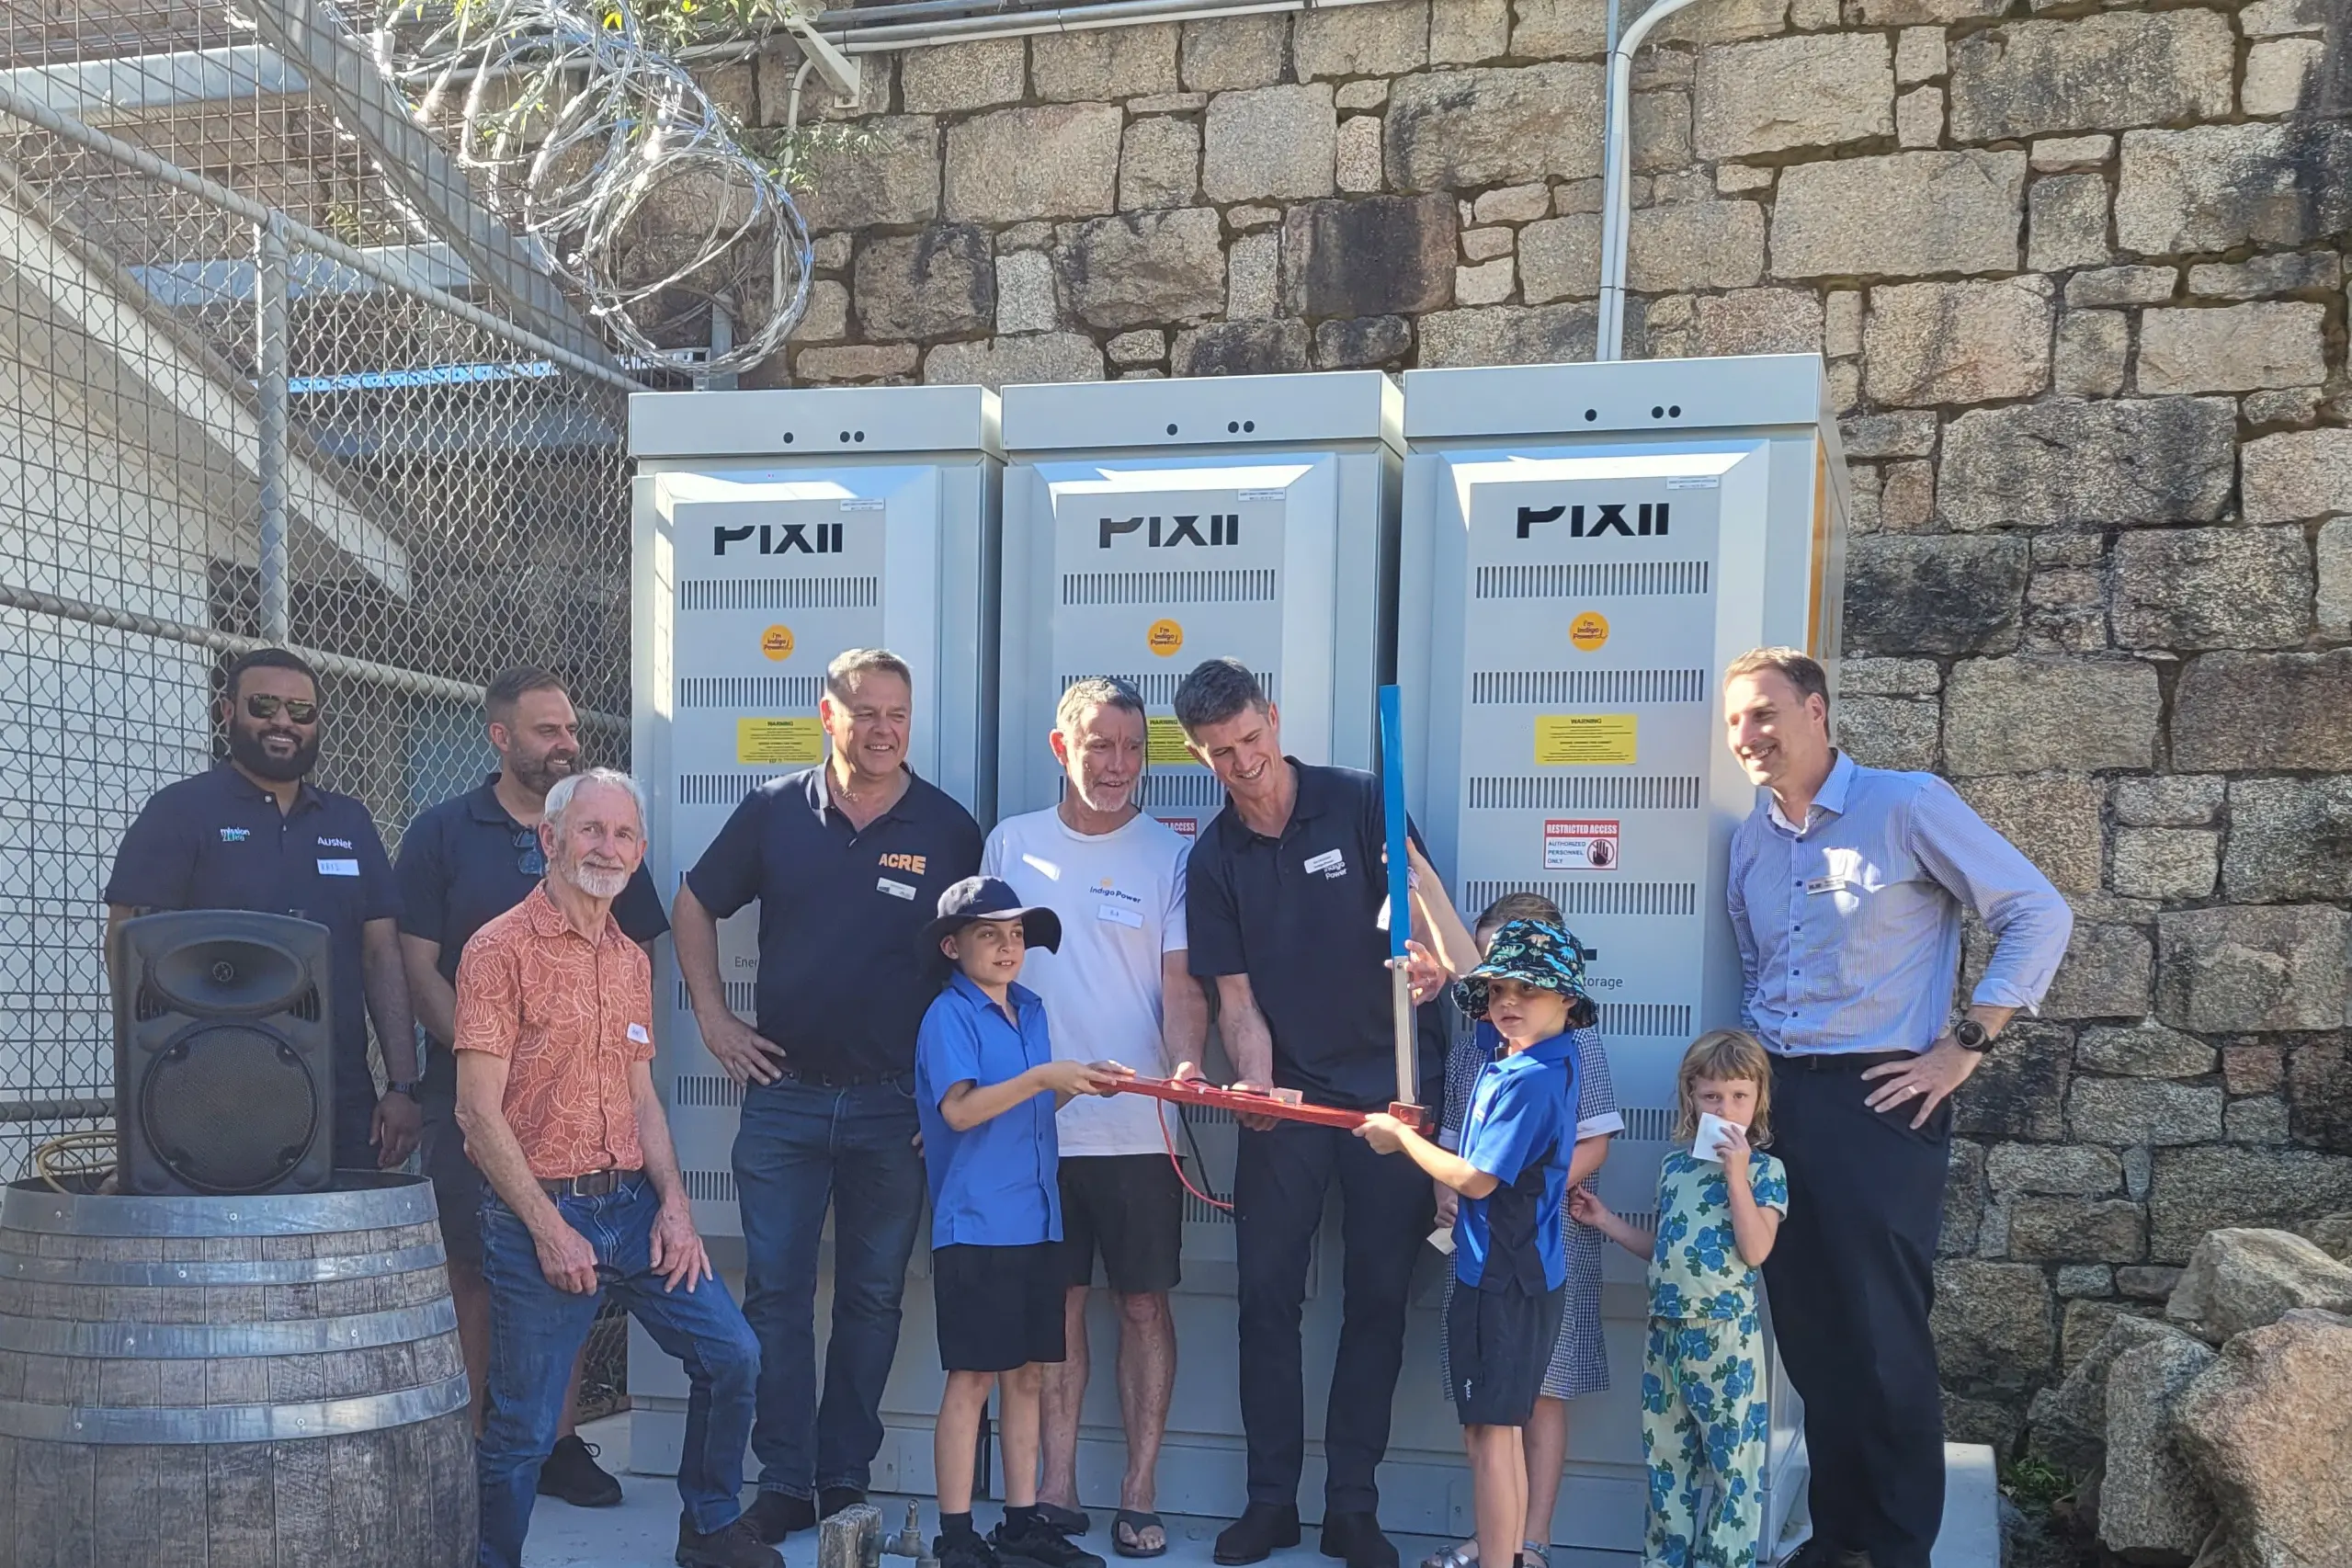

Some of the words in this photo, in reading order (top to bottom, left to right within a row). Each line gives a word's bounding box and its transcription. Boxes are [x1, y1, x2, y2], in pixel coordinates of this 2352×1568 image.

[1517, 503, 1670, 540] PIXII
[714, 523, 843, 556] PIXII
[1099, 515, 1239, 550] PIXII
[1546, 824, 1589, 835] RESTRICTED
[1589, 824, 1618, 835] ACCESS
[317, 835, 353, 850] AusNet
[879, 853, 926, 876] ACRE
[1090, 886, 1115, 897] Indigo
[1116, 890, 1142, 903] Power
[734, 955, 758, 968] Ener
[1584, 976, 1623, 991] torage
